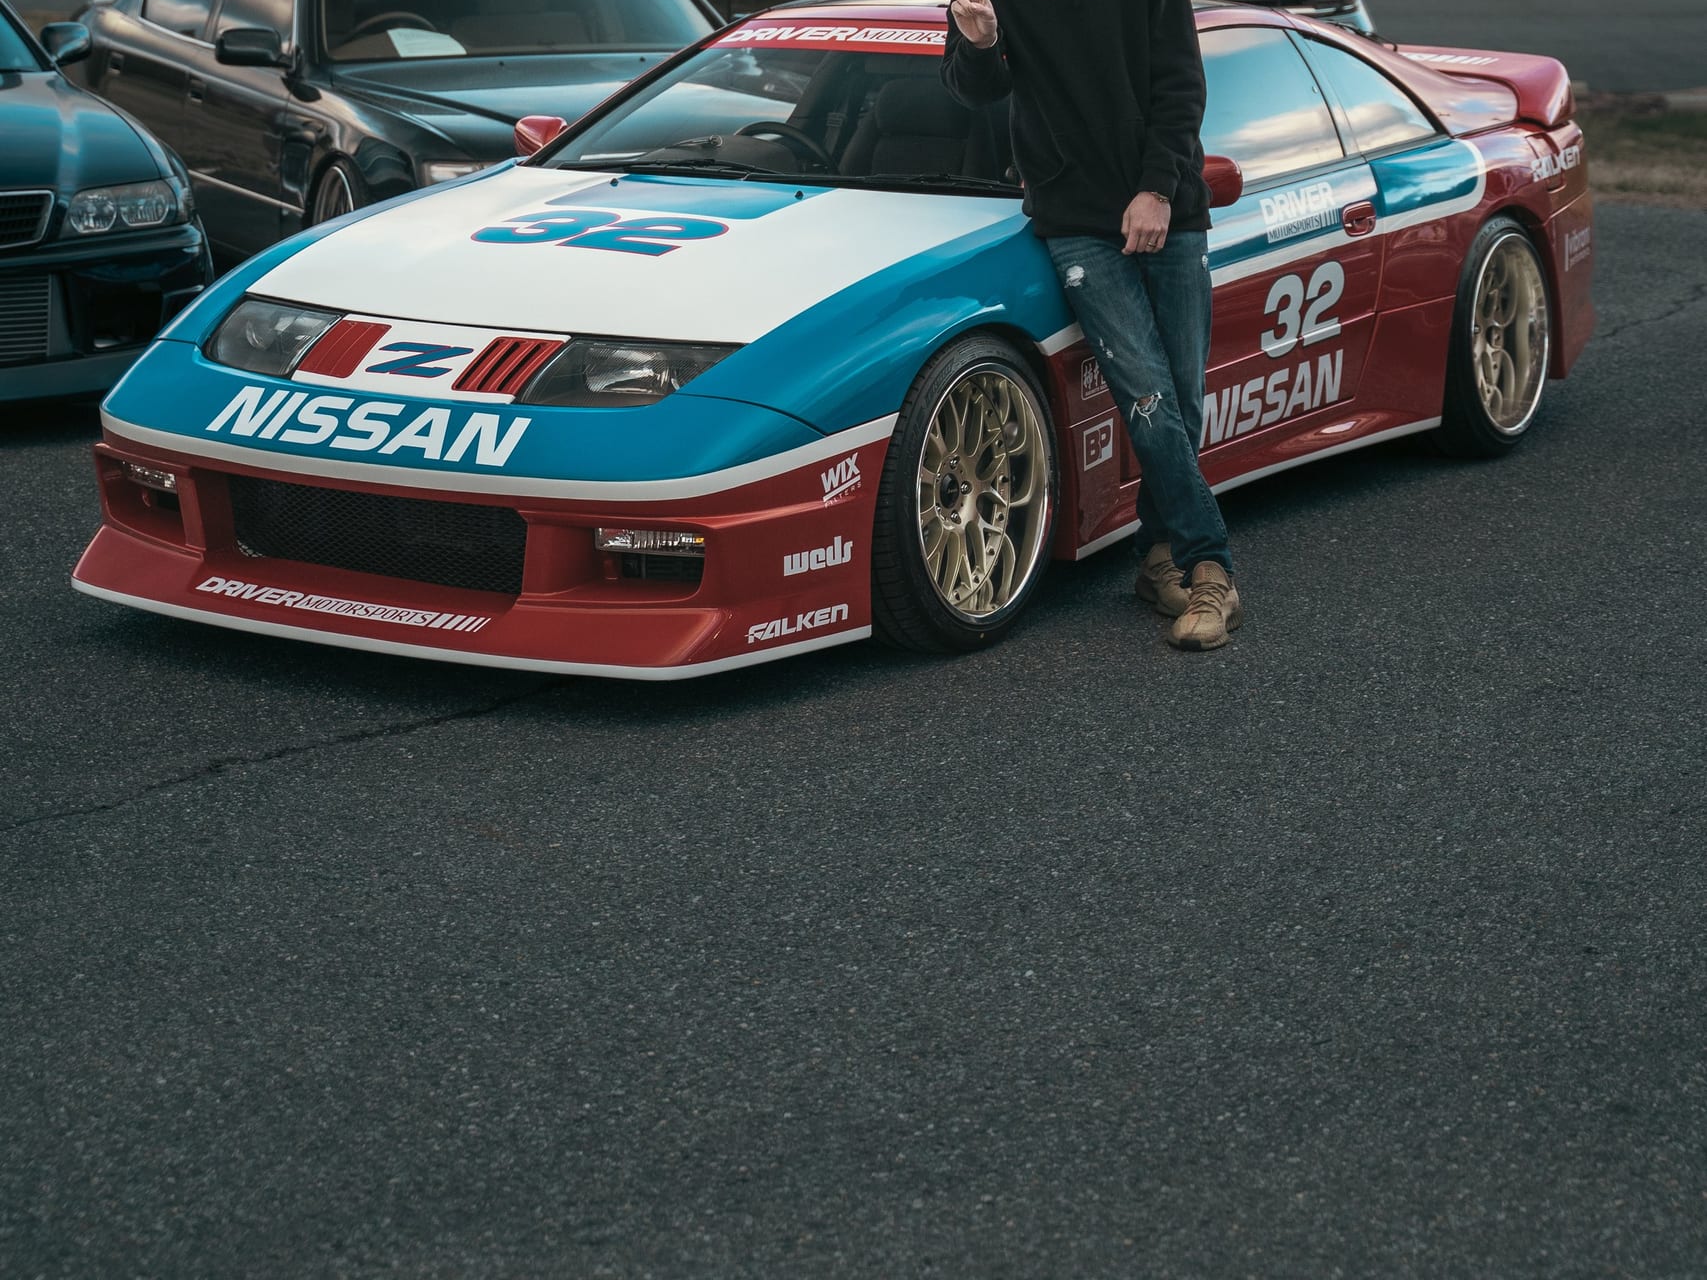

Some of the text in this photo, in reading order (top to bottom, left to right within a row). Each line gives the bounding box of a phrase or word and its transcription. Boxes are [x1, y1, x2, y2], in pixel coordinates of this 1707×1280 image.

[718, 26, 859, 43] DRIVER
[1531, 144, 1580, 182] FALKEN
[1260, 182, 1336, 225] DRIVER
[470, 210, 729, 256] 32
[1268, 214, 1321, 241] MOTORSPORTS
[1261, 260, 1345, 359] 32
[1200, 348, 1344, 449] NISSAN
[205, 385, 532, 467] NISSAN
[1085, 424, 1112, 467] BP
[820, 452, 861, 493] WIX
[823, 481, 862, 509] FILTERS
[783, 536, 854, 577] weds
[196, 576, 438, 626] DRIVER MOTORSPORTS
[745, 603, 849, 644] FALKEN
